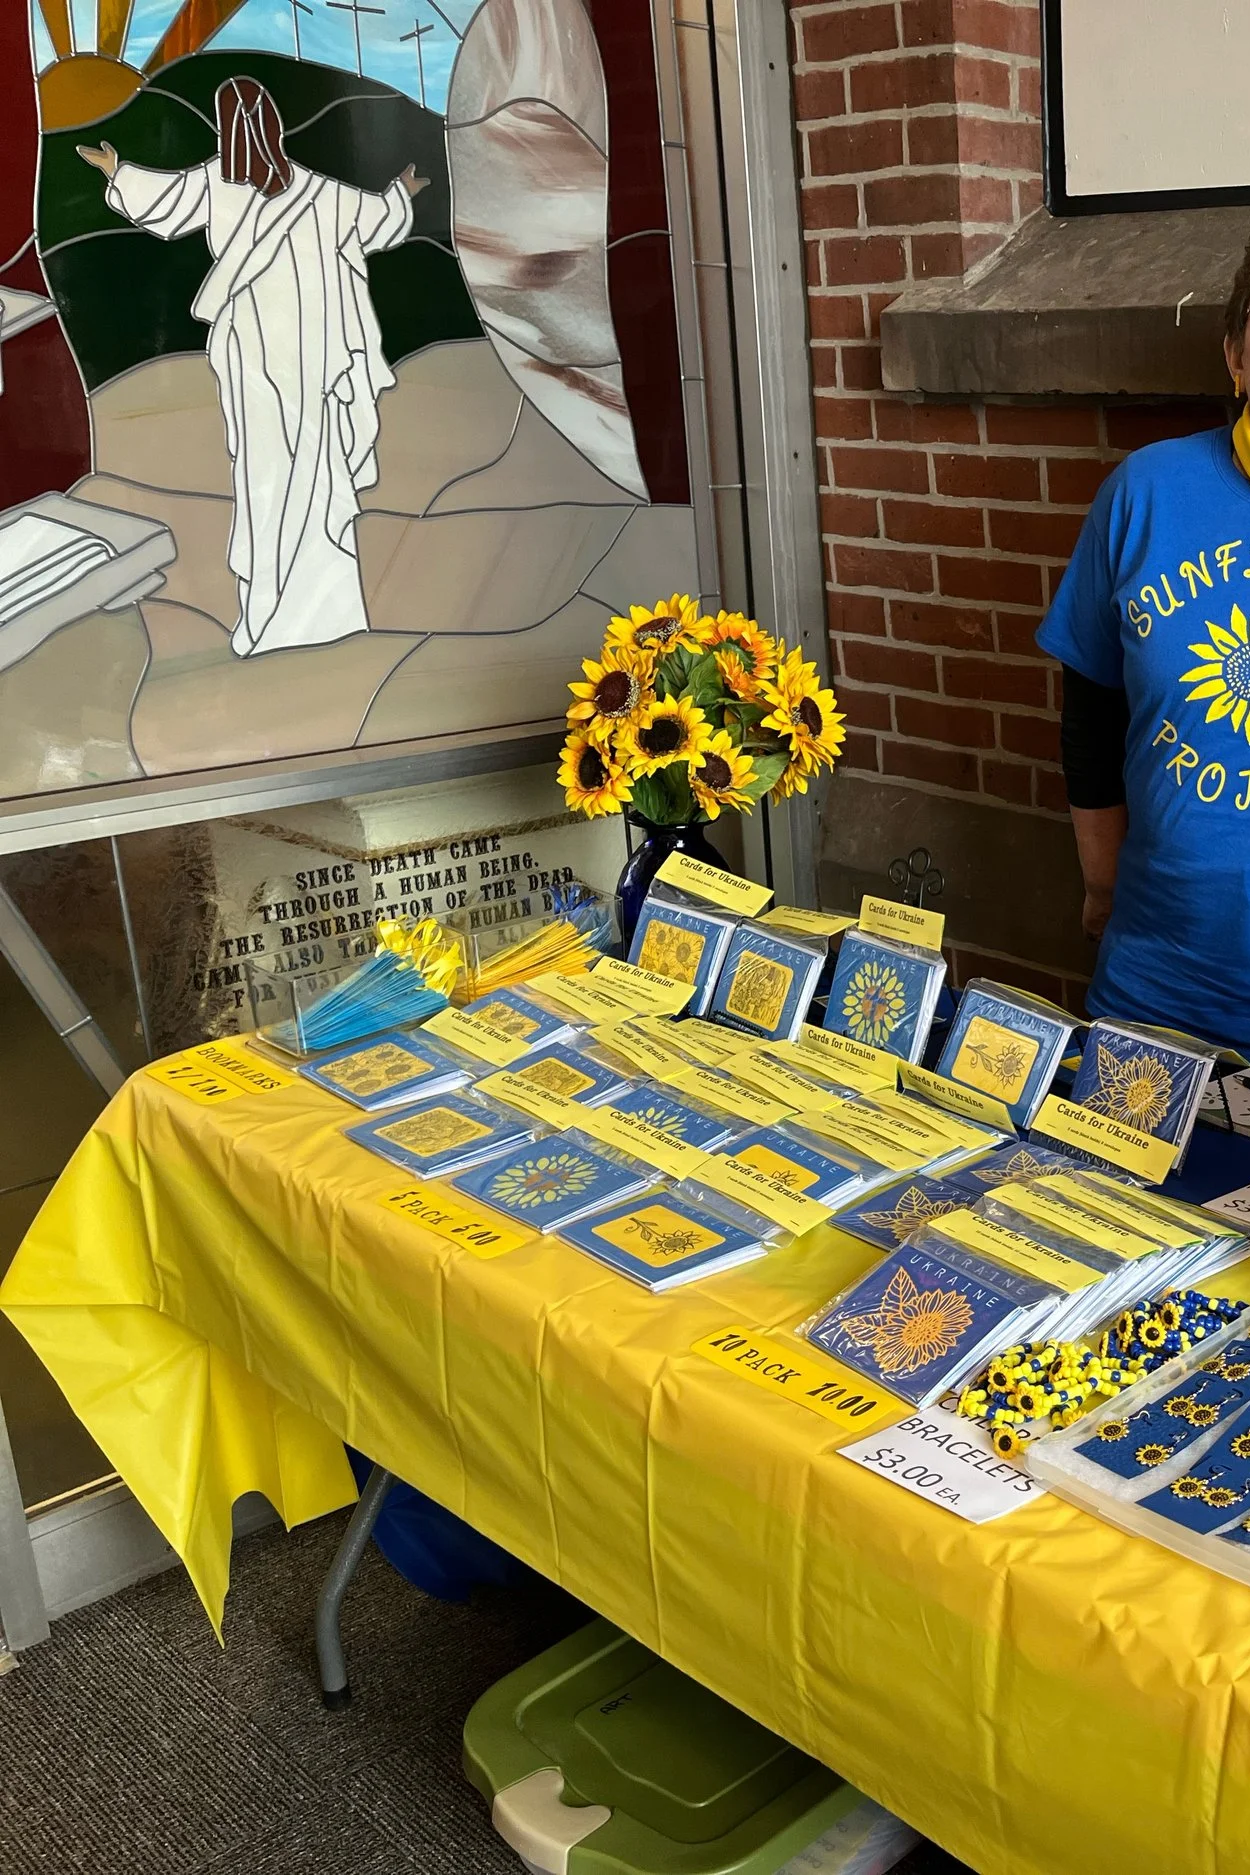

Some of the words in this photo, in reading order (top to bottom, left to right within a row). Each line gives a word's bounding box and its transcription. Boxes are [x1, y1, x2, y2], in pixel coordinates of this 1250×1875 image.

[296, 863, 355, 891] SINCE
[371, 848, 436, 877] DEATH
[450, 833, 501, 860] CAME
[680, 857, 702, 873] Cards
[706, 866, 718, 877] for
[719, 872, 752, 892] Ukraine
[259, 887, 360, 924] THROUGH
[374, 882, 387, 901] A
[400, 865, 467, 896] HUMAN
[479, 852, 539, 879] BEING.
[220, 933, 265, 959] THE
[281, 896, 433, 946] RESURRECTION
[446, 890, 467, 910] OF
[481, 878, 516, 902] THE
[528, 866, 575, 892] DEAD
[470, 897, 531, 929] HUMAN
[868, 902, 886, 914] Cards
[887, 907, 898, 918] for
[898, 910, 925, 926] Ukraine
[274, 944, 324, 973] ALSO
[609, 960, 632, 976] Cards
[632, 968, 644, 979] for
[644, 972, 675, 989] Ukraine
[851, 943, 916, 975] UKRAINE
[556, 974, 578, 989] Cards
[576, 984, 588, 994] for
[587, 989, 617, 1009] Ukraine
[451, 1011, 474, 1026] Cards
[471, 1019, 484, 1030] for
[482, 1023, 512, 1045] Ukraine
[613, 1026, 634, 1043] Cards
[631, 1039, 644, 1050] for
[644, 1043, 669, 1063] Ukraine
[807, 1029, 830, 1044] Cards
[831, 1038, 843, 1048] for
[845, 1042, 876, 1061] Ukraine
[196, 1047, 281, 1090] BOOKMARKS
[749, 1054, 773, 1068] Cards
[772, 1064, 786, 1074] for
[786, 1072, 818, 1092] Ukraine
[501, 1075, 524, 1091] Cards
[521, 1084, 534, 1094] for
[534, 1087, 569, 1108] Ukraine
[696, 1071, 721, 1088] Cards
[720, 1080, 735, 1091] for
[735, 1084, 771, 1107] Ukraine
[907, 1070, 932, 1087] Cards
[932, 1083, 947, 1094] for
[947, 1087, 984, 1110] Ukraine
[610, 1111, 635, 1127] Cards
[634, 1122, 652, 1133] for
[651, 1128, 687, 1151] Ukraine
[842, 1102, 870, 1116] Cards
[870, 1111, 887, 1121] for
[889, 1118, 930, 1138] Ukraine
[1057, 1104, 1086, 1122] Cards
[1088, 1117, 1105, 1129] for
[1106, 1124, 1149, 1149] Ukraine
[766, 1135, 838, 1174] UKRAINE
[389, 1191, 413, 1201] 5
[725, 1159, 755, 1176] Cards
[751, 1172, 770, 1184] for
[767, 1180, 807, 1204] Ukraine
[400, 1200, 453, 1225] PACK
[1026, 1189, 1060, 1205] Cards
[1059, 1200, 1078, 1214] for
[1081, 1209, 1130, 1237] Ukraine
[451, 1223, 502, 1246] 5.00
[971, 1215, 1006, 1234] Cards
[1004, 1230, 1027, 1242] for
[1025, 1237, 1072, 1265] Ukraine
[909, 1254, 999, 1308] UKRAINE
[709, 1329, 739, 1352] 10
[736, 1349, 801, 1385] PACK
[805, 1381, 879, 1417] 10.00
[898, 1417, 1035, 1494] BRACELETS
[863, 1448, 943, 1488] $3.00
[934, 1486, 959, 1506] EA.
[601, 1693, 633, 1716] ART
